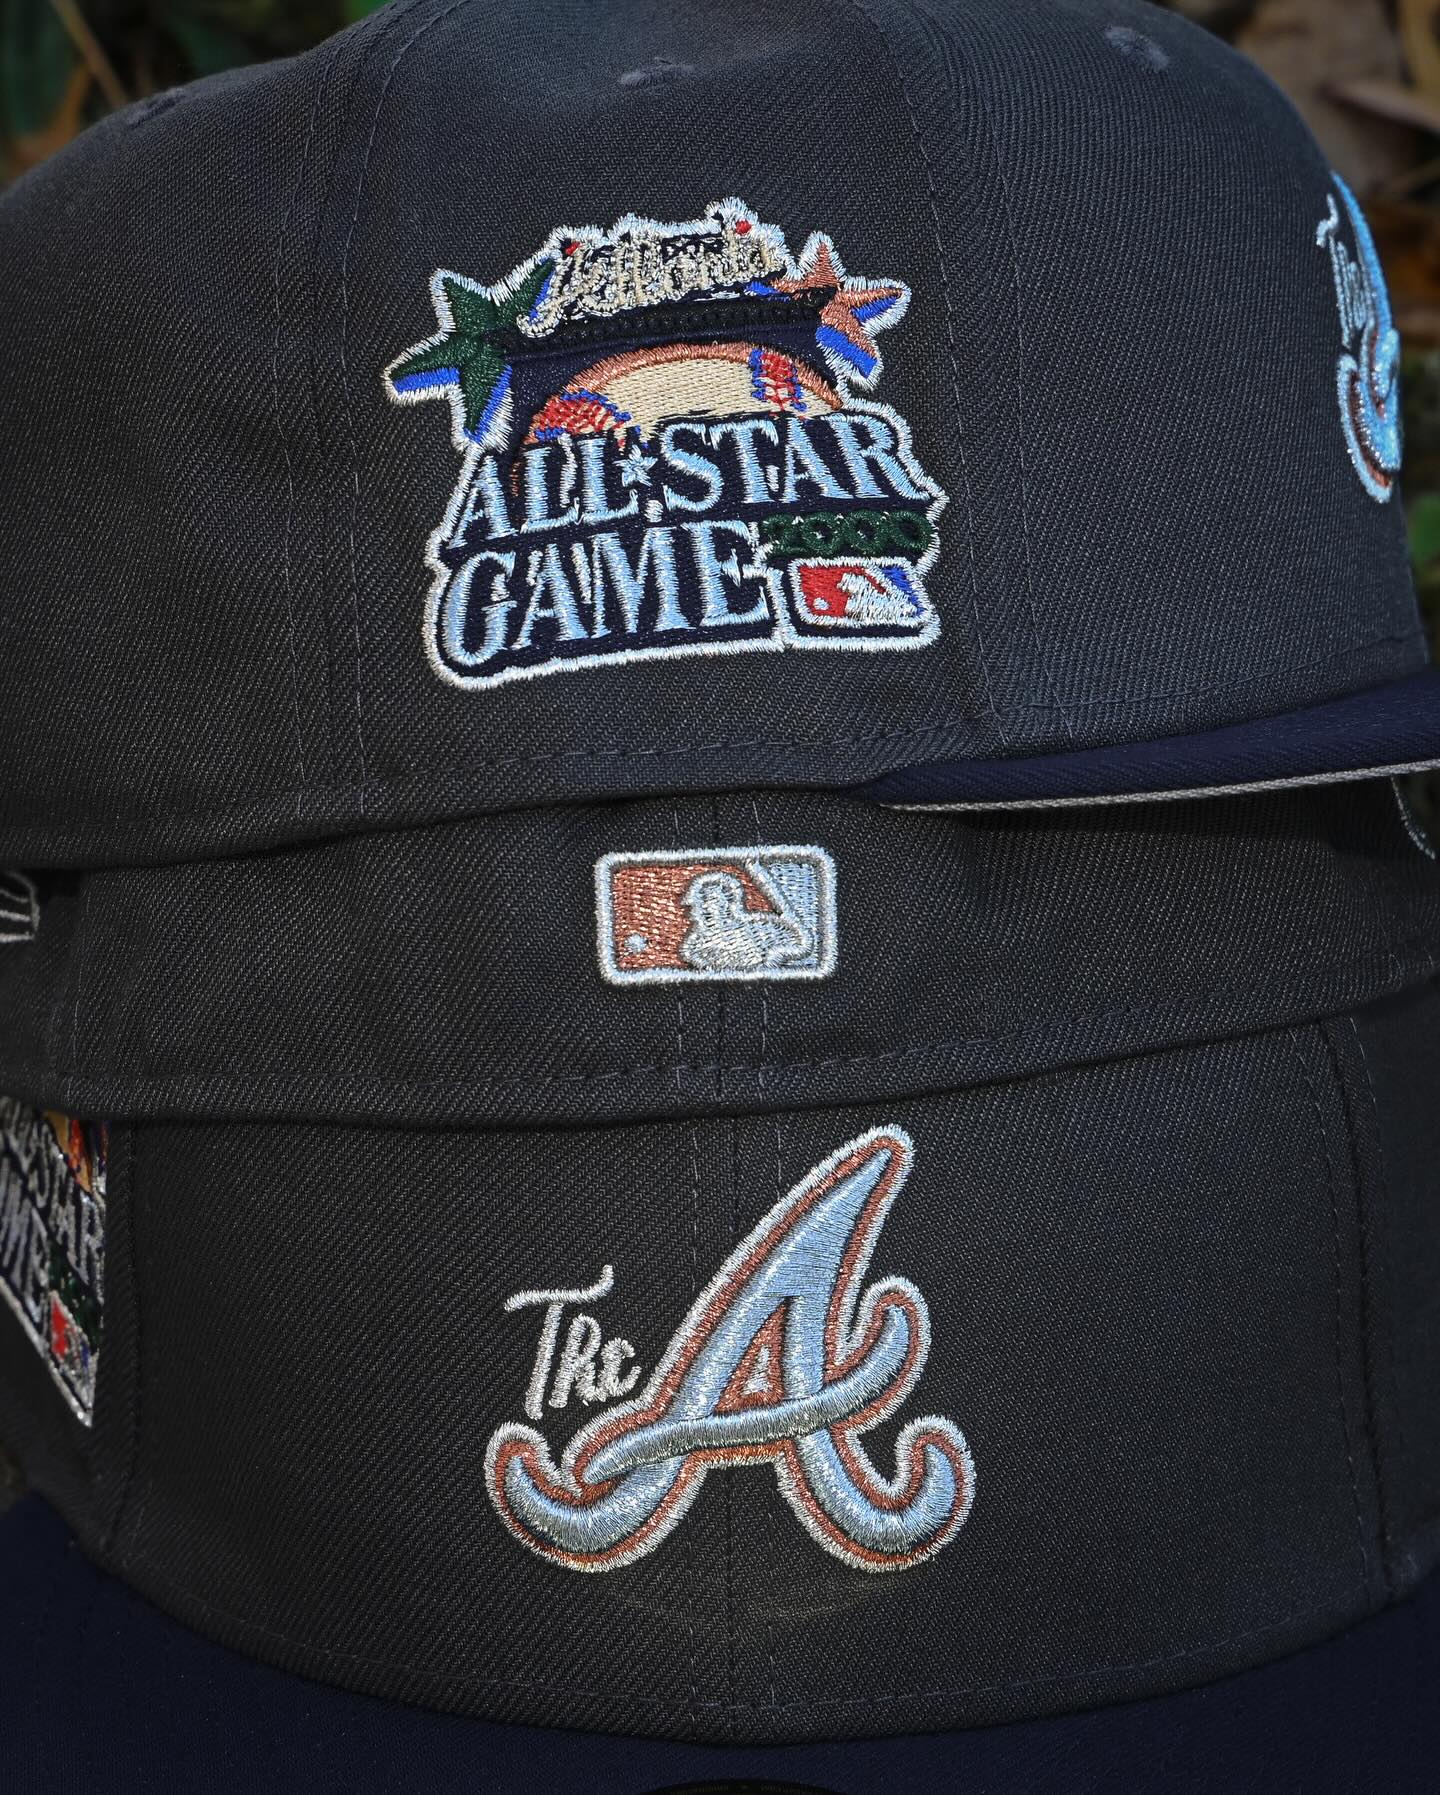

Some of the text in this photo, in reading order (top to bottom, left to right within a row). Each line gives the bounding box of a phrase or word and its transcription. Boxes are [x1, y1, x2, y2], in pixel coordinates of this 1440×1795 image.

[449, 412, 931, 549] ALL STAR
[763, 510, 935, 557] 2000
[442, 519, 769, 666] GAME
[485, 1123, 976, 1573] The A
